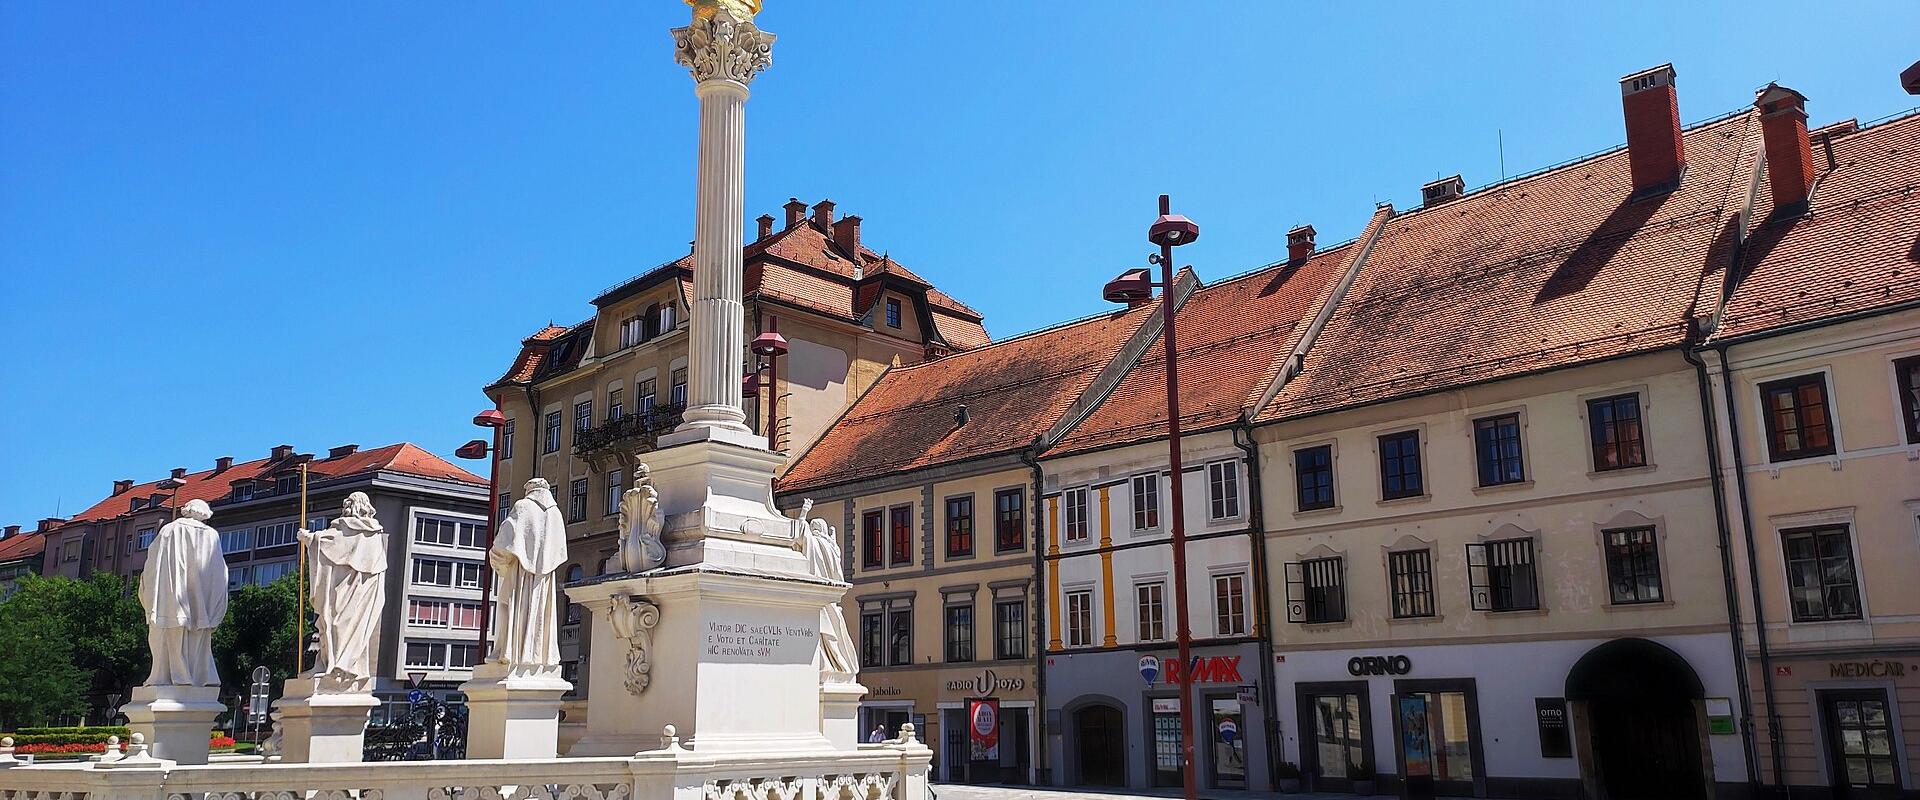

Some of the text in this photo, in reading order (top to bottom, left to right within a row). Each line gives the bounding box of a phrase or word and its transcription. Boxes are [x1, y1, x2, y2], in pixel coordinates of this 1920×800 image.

[735, 623, 747, 634] DIC
[736, 636, 745, 645] ET
[1164, 655, 1243, 685] R/MAX
[1348, 654, 1411, 676] ORNO
[1829, 659, 1905, 678] MEDIČAR
[946, 680, 973, 691] RADIO
[996, 678, 1025, 691] 107.9
[872, 686, 901, 698] jabolko
